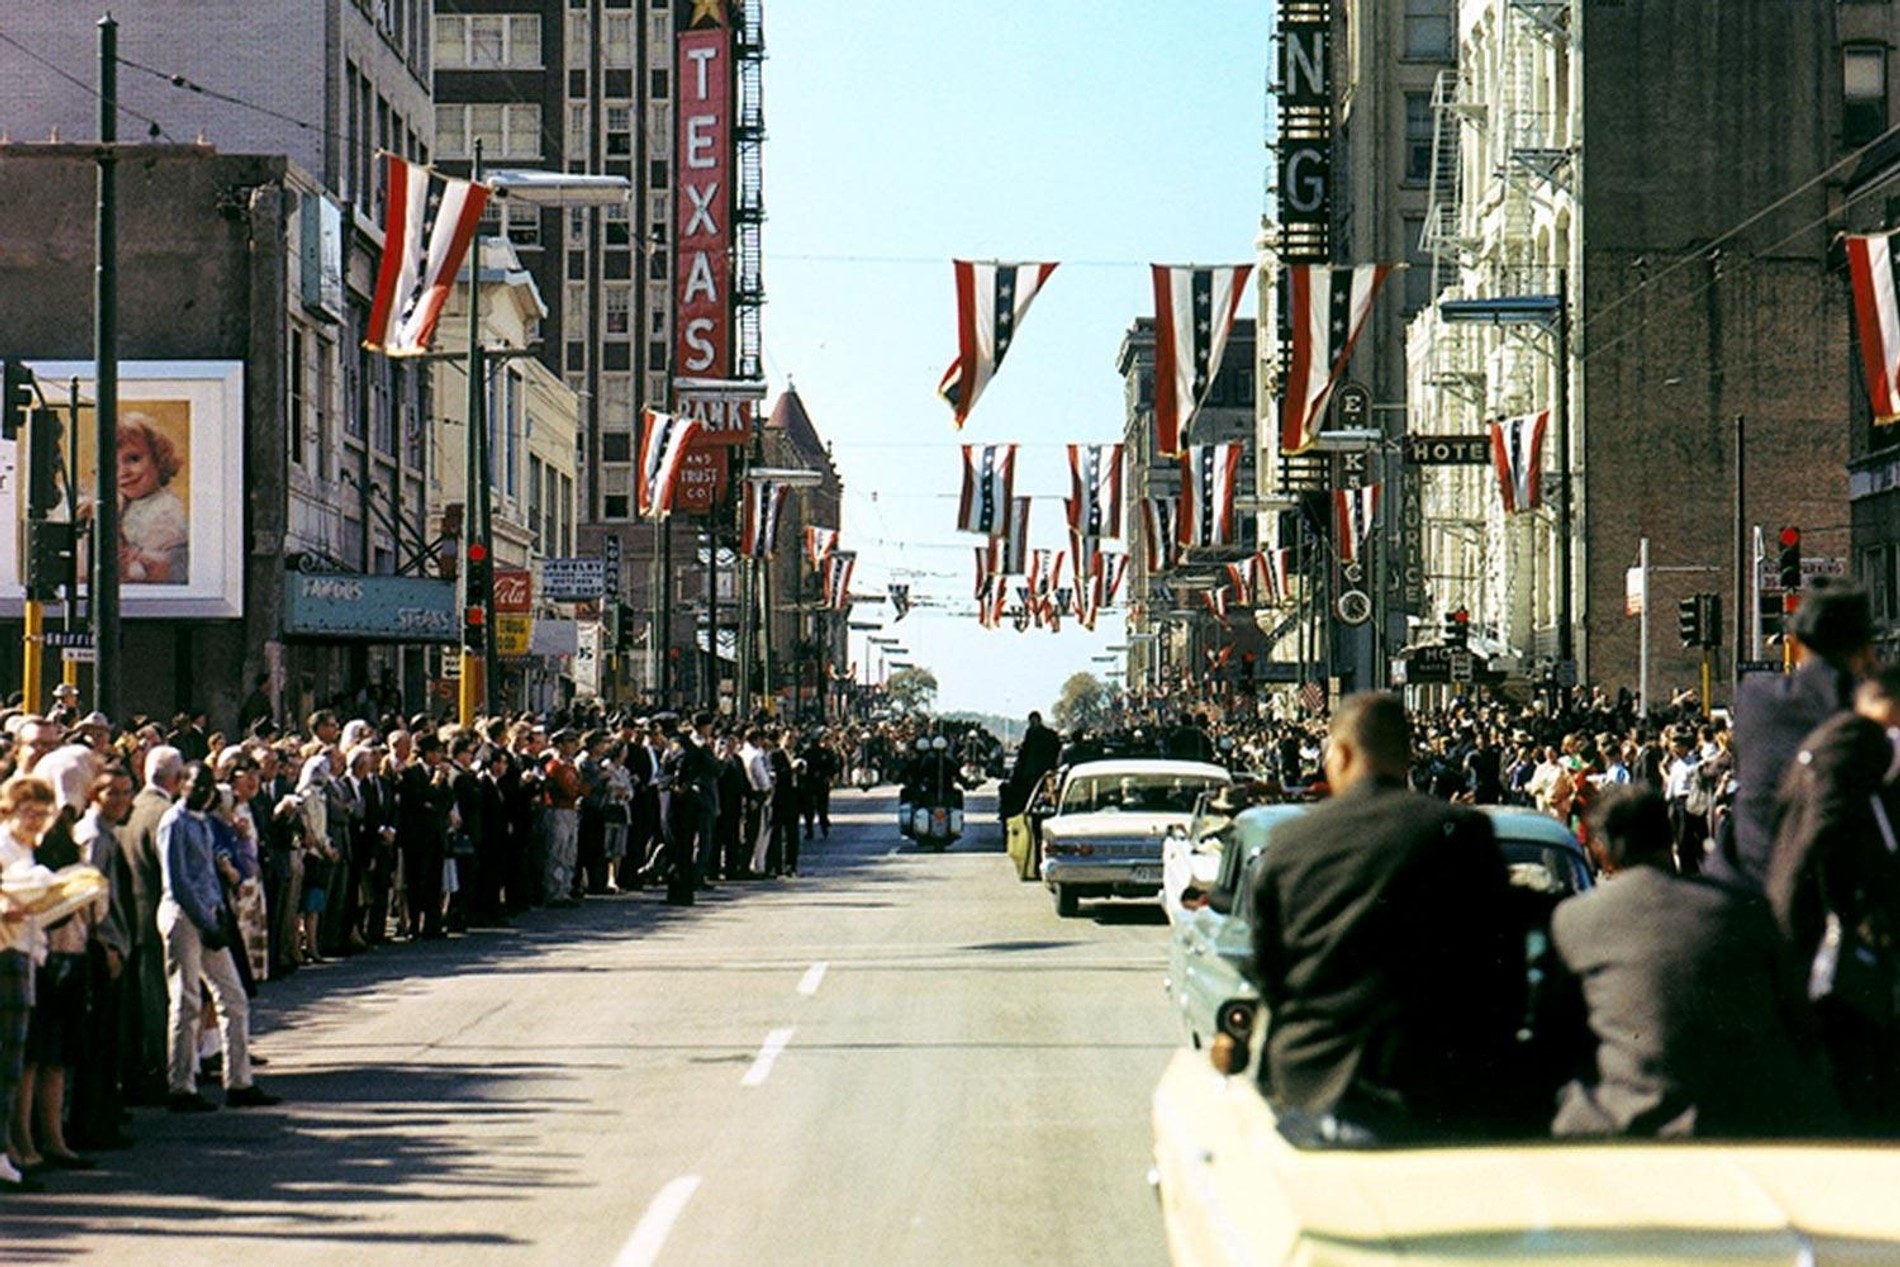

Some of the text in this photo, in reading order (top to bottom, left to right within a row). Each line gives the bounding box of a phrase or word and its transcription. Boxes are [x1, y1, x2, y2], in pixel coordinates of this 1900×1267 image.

[686, 47, 717, 372] TEXAS
[1414, 443, 1485, 460] HOTE
[681, 468, 717, 483] TRUST
[1404, 473, 1419, 602] MAURICE
[303, 577, 363, 599] FAMOUS
